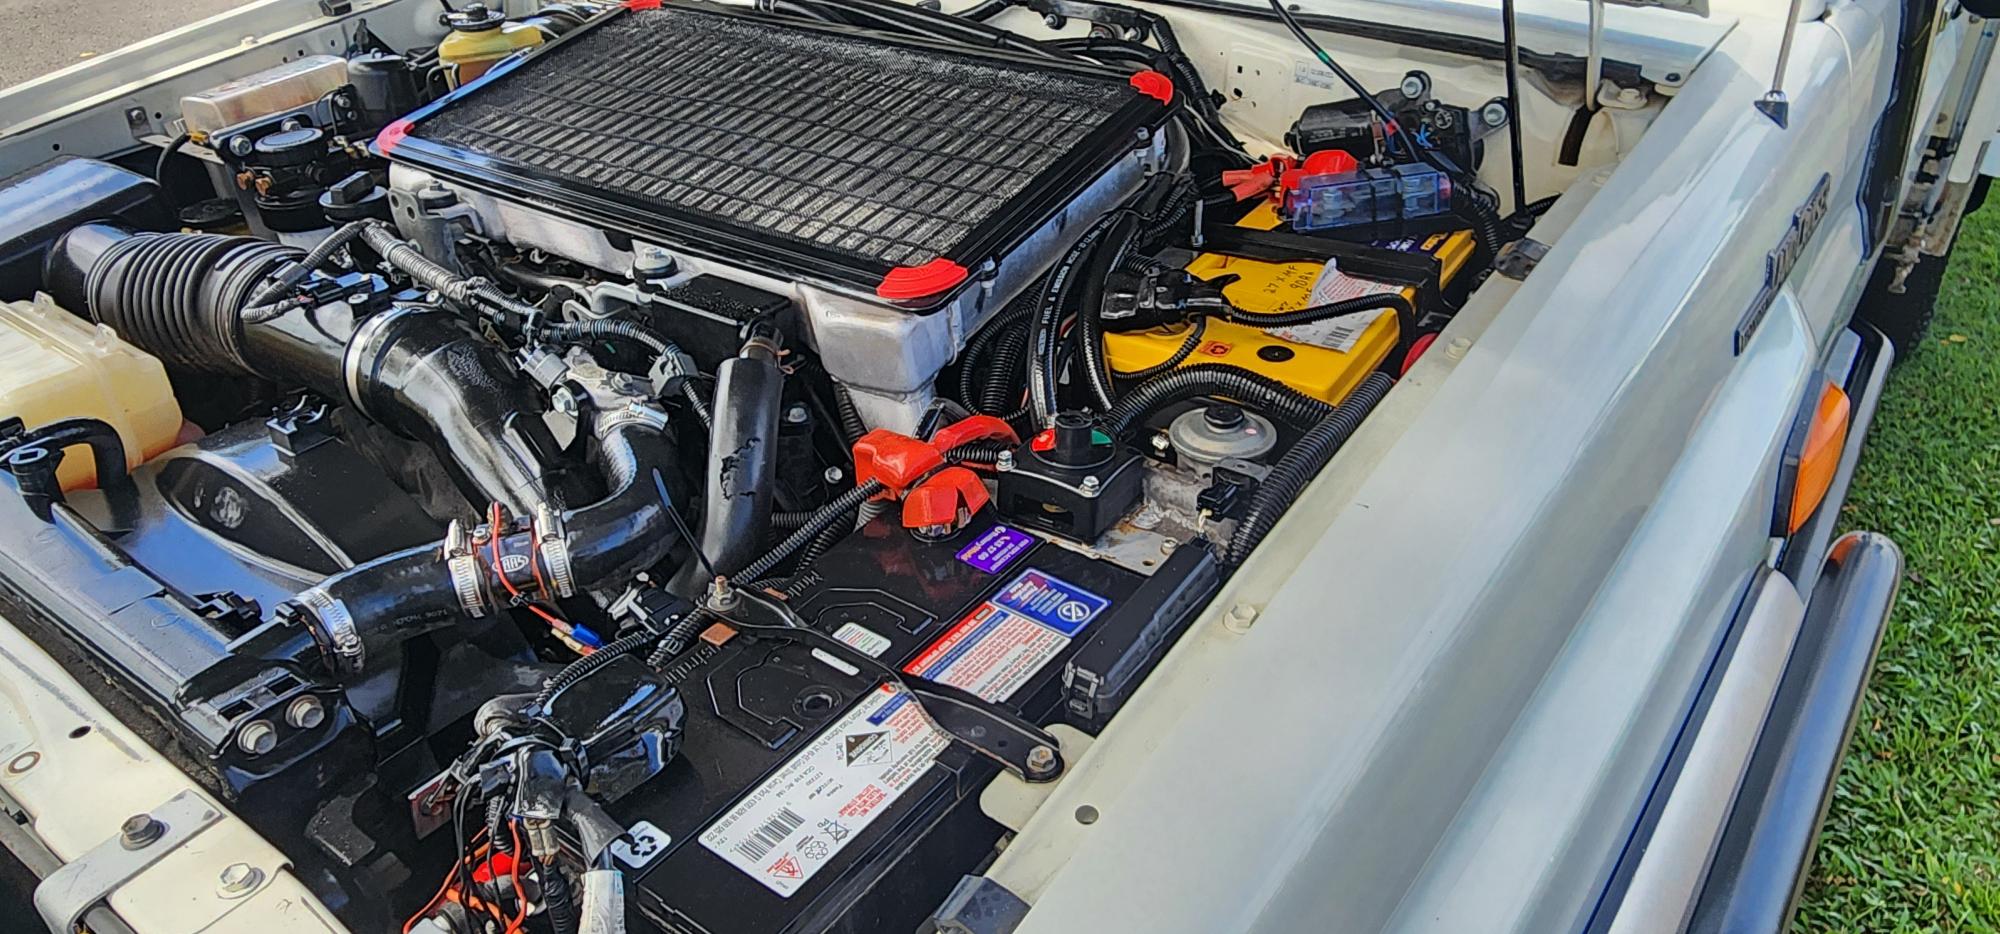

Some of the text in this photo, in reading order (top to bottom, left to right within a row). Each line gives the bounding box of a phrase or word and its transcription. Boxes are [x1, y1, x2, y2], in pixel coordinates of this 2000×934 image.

[1042, 303, 1053, 325] FUEL
[1050, 264, 1070, 293] EMISSION
[1065, 249, 1080, 265] HOSE
[815, 817, 831, 830] Pb
